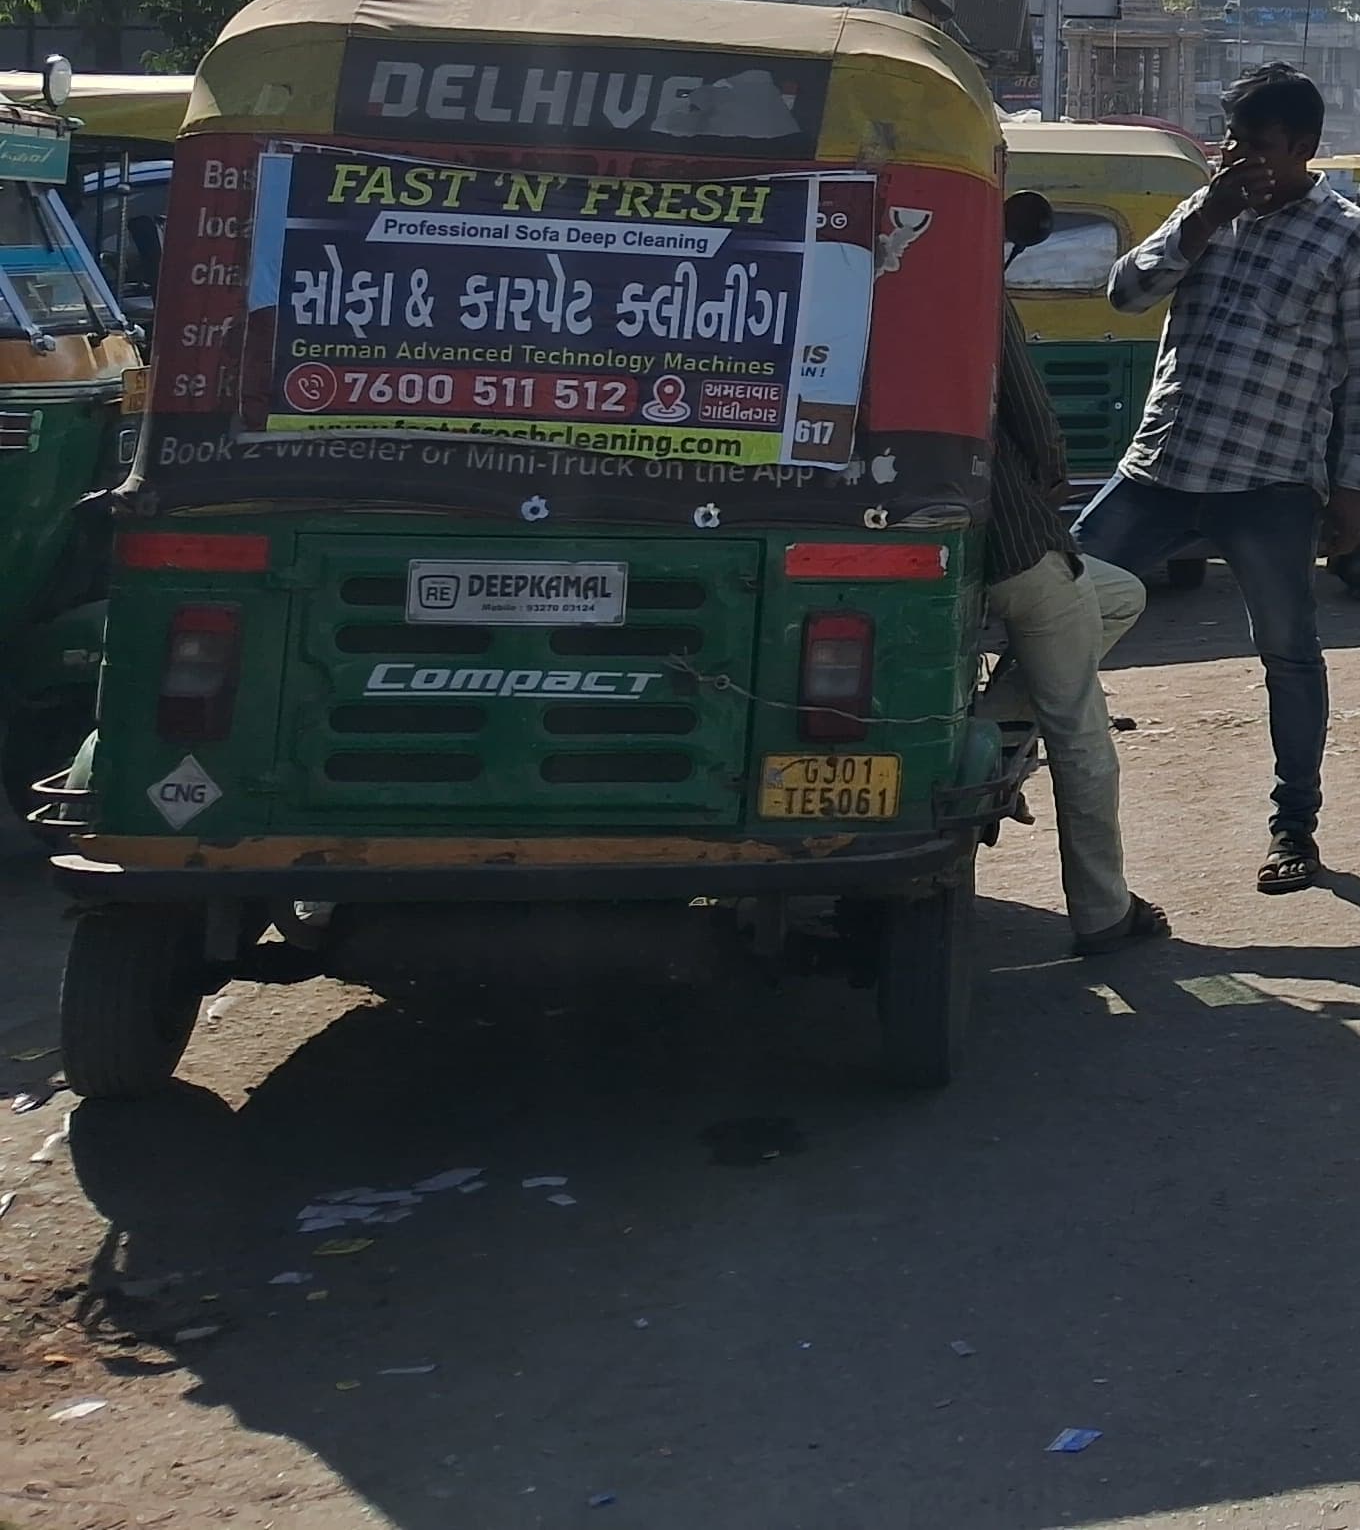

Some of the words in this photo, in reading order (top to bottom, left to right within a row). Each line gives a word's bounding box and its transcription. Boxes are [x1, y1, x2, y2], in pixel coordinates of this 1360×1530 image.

[327, 163, 477, 207] FAST
[580, 178, 771, 224] FRESH
[384, 218, 510, 240] Professional
[515, 224, 560, 243] Sofa
[566, 227, 617, 247] Deep
[623, 229, 709, 253] Cleaning
[291, 244, 394, 339] સોફા
[405, 268, 434, 328] &
[459, 253, 593, 335] કારપેટ
[291, 338, 387, 359] German
[396, 341, 513, 363] Advanced
[521, 345, 655, 374] Technology
[664, 351, 775, 375] Machines
[344, 372, 454, 405] 7600
[472, 375, 536, 407] 511
[554, 379, 627, 412] 512
[704, 383, 780, 402] અમદાવાદ
[701, 401, 777, 423] ગાંધીનગર
[159, 435, 233, 465] Book
[422, 445, 456, 465] or
[466, 443, 634, 477] Mini-Truck
[644, 458, 684, 480] on
[752, 463, 815, 489] App
[467, 574, 612, 600] DEEPKAMAL
[159, 782, 207, 806] CNG
[784, 787, 887, 815] TE5061
